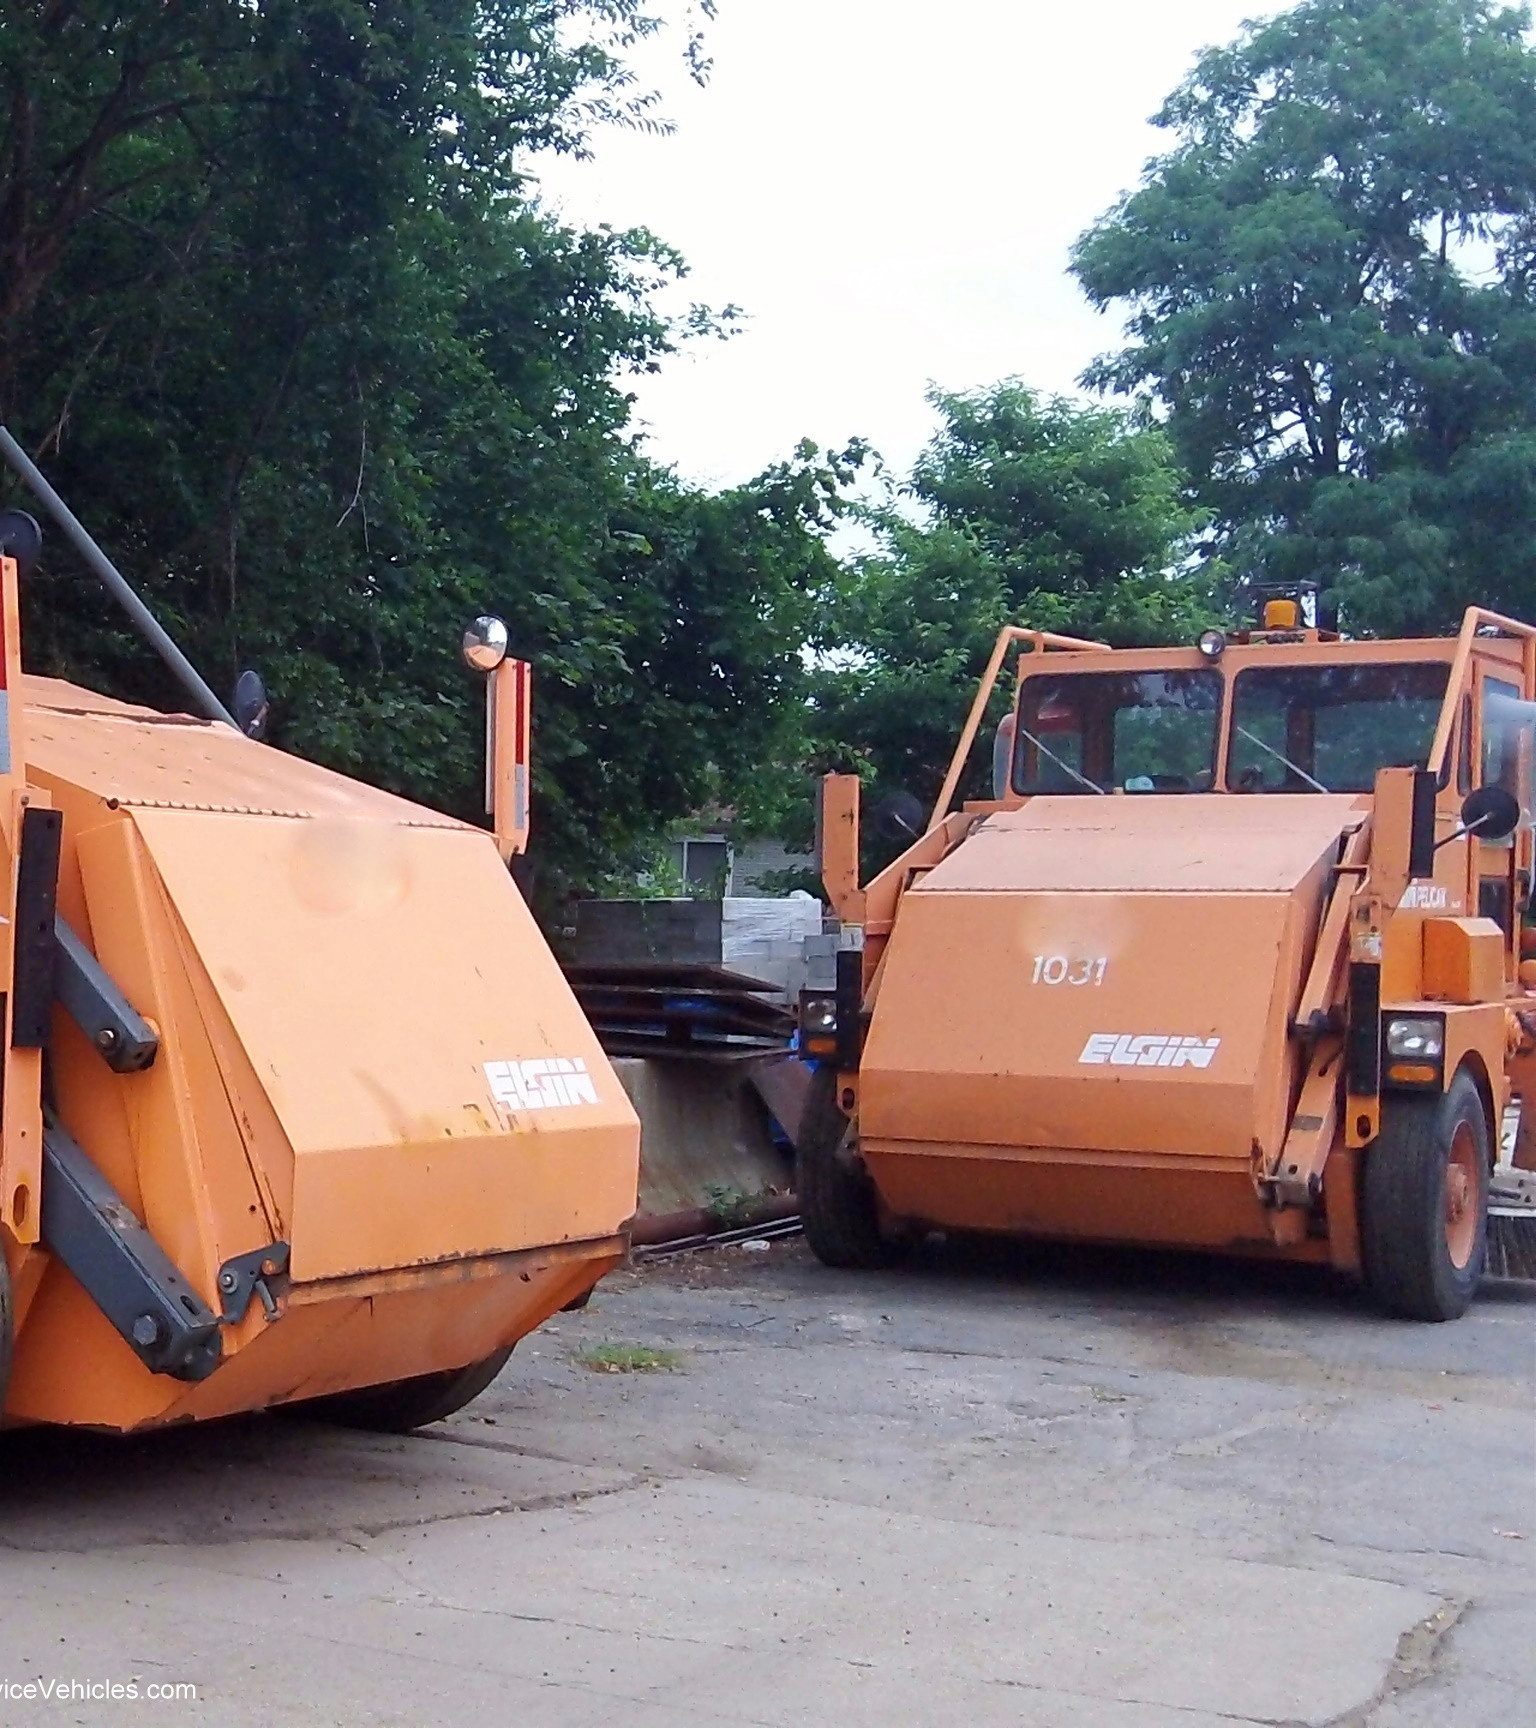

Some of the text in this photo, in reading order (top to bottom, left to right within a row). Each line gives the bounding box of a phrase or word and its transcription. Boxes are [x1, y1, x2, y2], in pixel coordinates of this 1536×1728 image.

[1032, 955, 1108, 987] 1031
[1078, 1032, 1222, 1069] ELGIN
[483, 1057, 600, 1110] ELGIN
